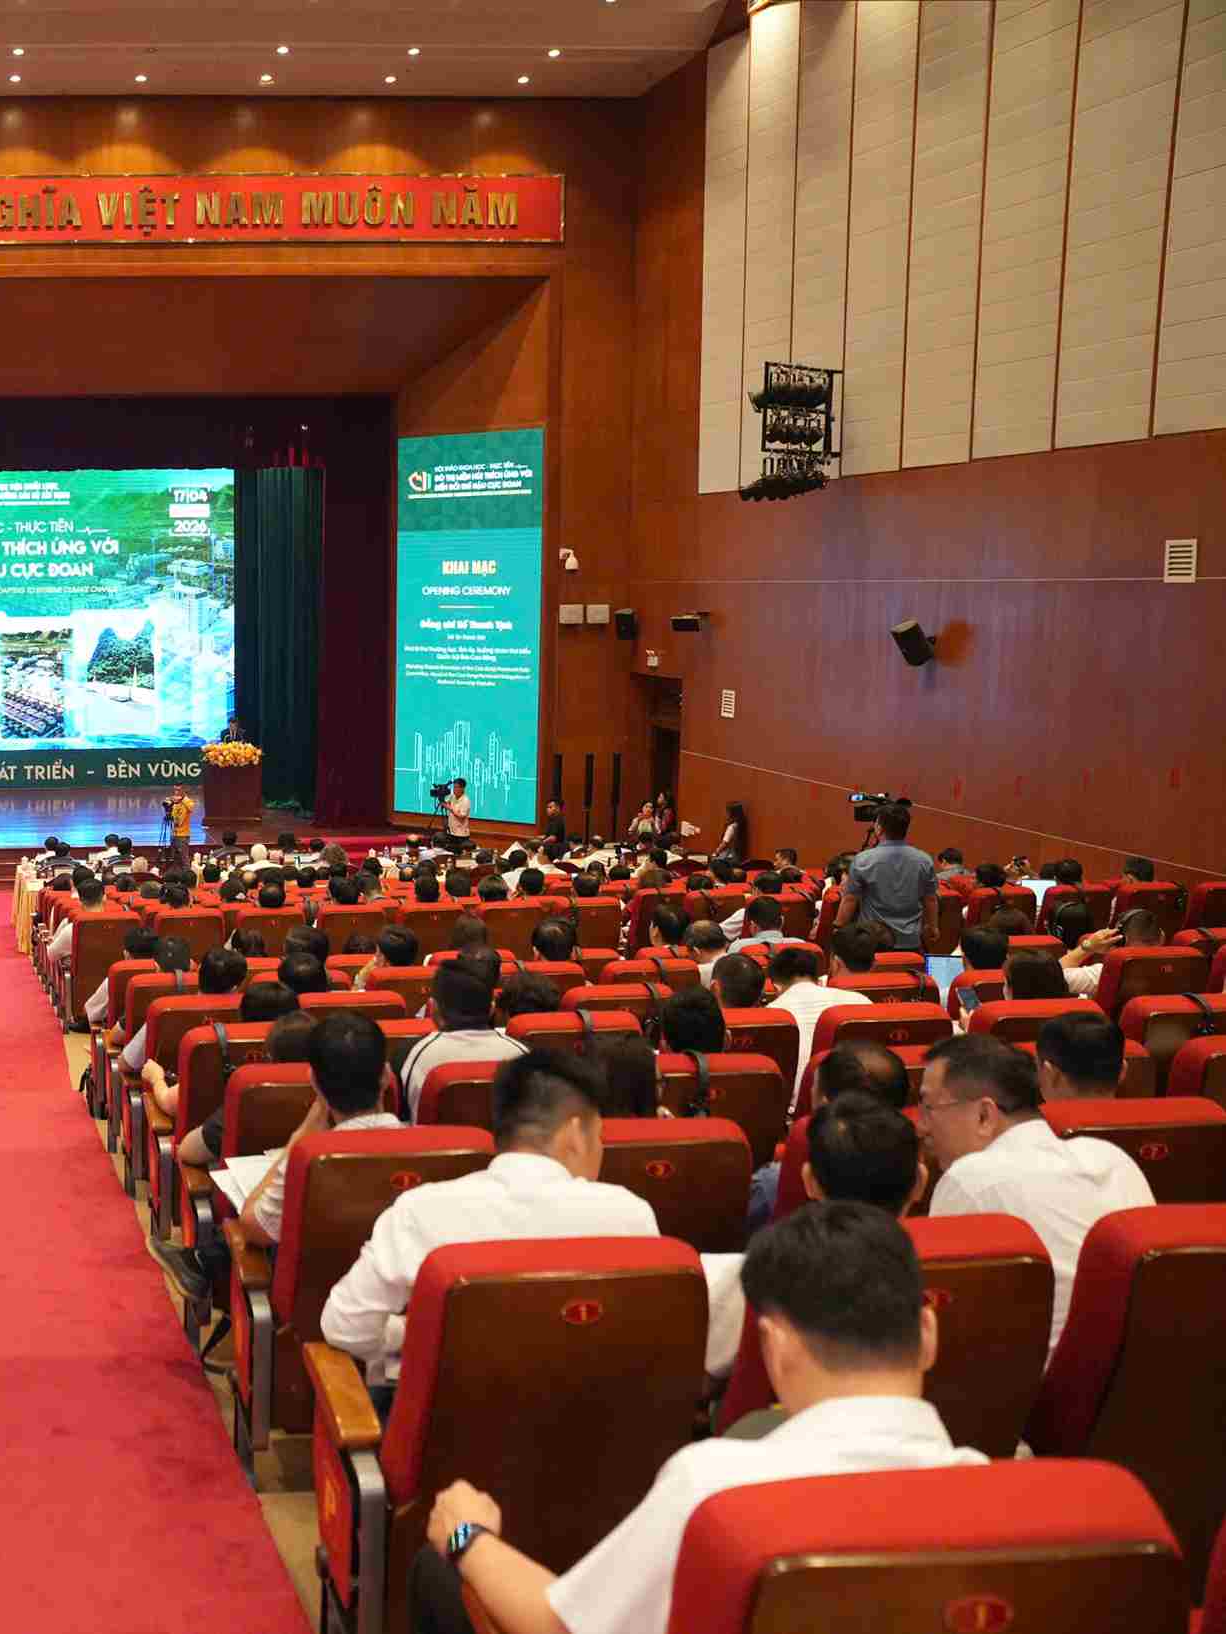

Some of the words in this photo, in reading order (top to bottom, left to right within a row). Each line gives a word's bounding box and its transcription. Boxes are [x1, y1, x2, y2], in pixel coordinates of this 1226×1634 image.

[96, 186, 180, 237] VIỆT
[195, 190, 285, 229] NAM
[301, 186, 415, 228] MUÔN
[431, 186, 520, 230] NĂM
[14, 521, 47, 535] THỰC
[2, 538, 46, 555] THÍCH
[90, 537, 119, 555] VỚI
[10, 562, 45, 580] CỰC
[48, 562, 94, 577] ĐOAN
[24, 758, 75, 780] TRIỂN
[106, 758, 141, 779] BỀN
[147, 759, 202, 778] VỮNG
